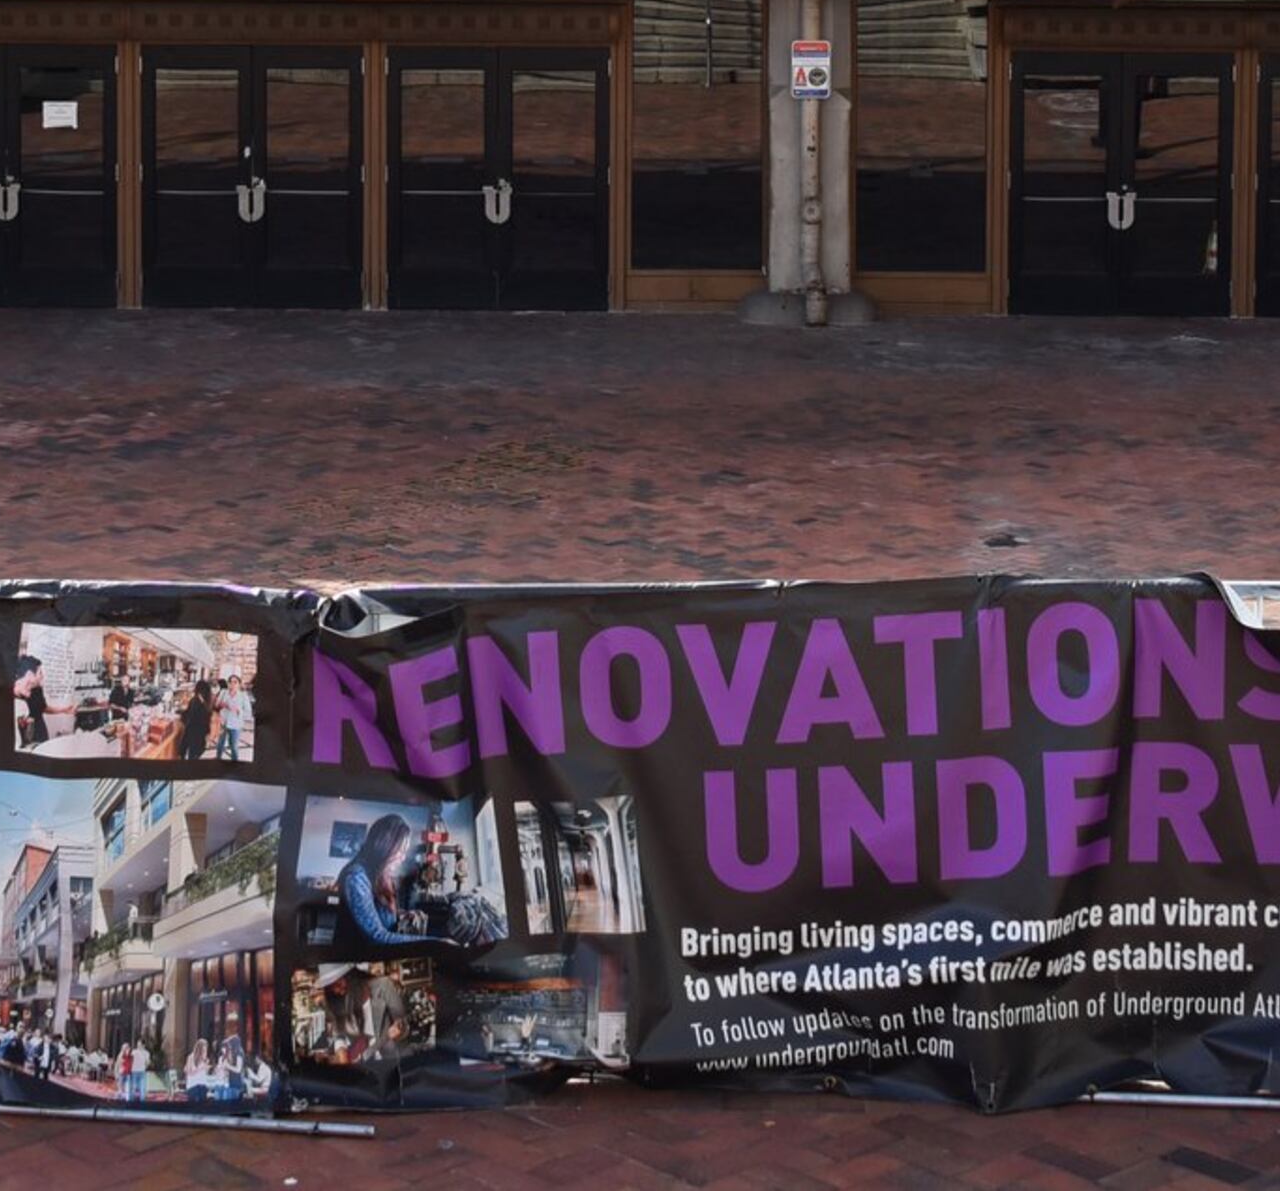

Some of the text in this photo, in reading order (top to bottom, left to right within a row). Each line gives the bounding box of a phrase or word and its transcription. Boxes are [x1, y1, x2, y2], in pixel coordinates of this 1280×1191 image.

[680, 926, 795, 958] Bringing
[800, 920, 877, 953] living
[881, 919, 984, 950] spaces,
[990, 903, 1103, 944] commerce
[1108, 897, 1157, 926] and
[1162, 897, 1259, 927] vibrant
[684, 974, 711, 1003] to
[714, 967, 798, 999] where
[927, 955, 987, 984] first
[989, 955, 1042, 983] mile
[1045, 950, 1087, 978] was
[1091, 941, 1255, 973] established.
[690, 1021, 715, 1048] To
[720, 1015, 787, 1045] follow
[792, 1007, 873, 1039] updates
[879, 1012, 906, 1033] on
[911, 1003, 946, 1027] the
[951, 994, 1080, 1031] transformation
[1086, 992, 1107, 1018] of
[1113, 991, 1246, 1021] Underground
